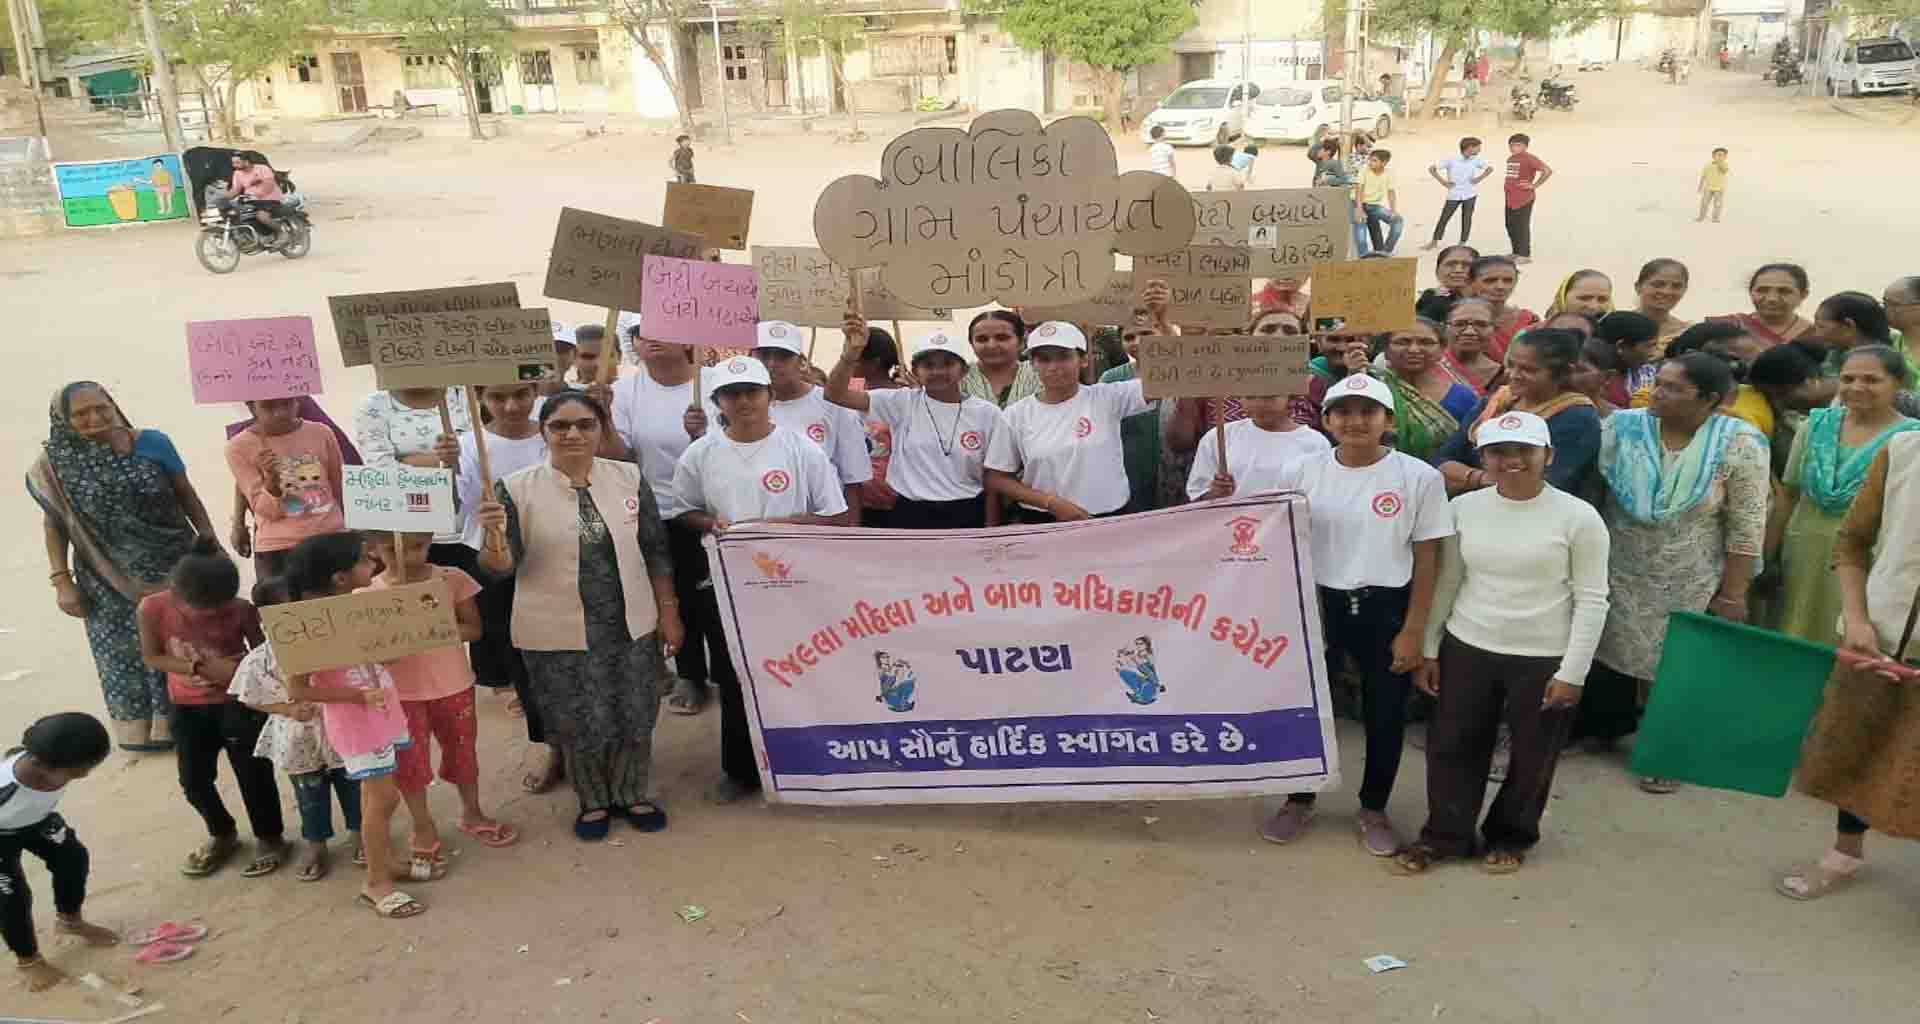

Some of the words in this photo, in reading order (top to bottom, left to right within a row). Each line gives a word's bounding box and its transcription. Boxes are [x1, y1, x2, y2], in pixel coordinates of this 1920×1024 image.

[893, 129, 1069, 187] બાલિકા
[854, 205, 960, 251] ગ્રામ
[992, 193, 1165, 241] પંચાયત
[762, 627, 844, 688] જિલ્લા
[841, 598, 917, 641] મહિલા
[923, 575, 975, 616] અને
[983, 581, 1042, 610] બાળ
[1053, 573, 1207, 631] અધિકારીની
[1209, 616, 1289, 670] કચેરી
[955, 644, 1073, 676] પાટણ
[827, 738, 889, 762] આપ
[899, 728, 966, 767] સૌનું
[969, 725, 1048, 758] હાર્દિક
[1057, 731, 1161, 756] સ્વાગત
[1170, 723, 1209, 754] કરે
[1216, 722, 1258, 753] છે.
